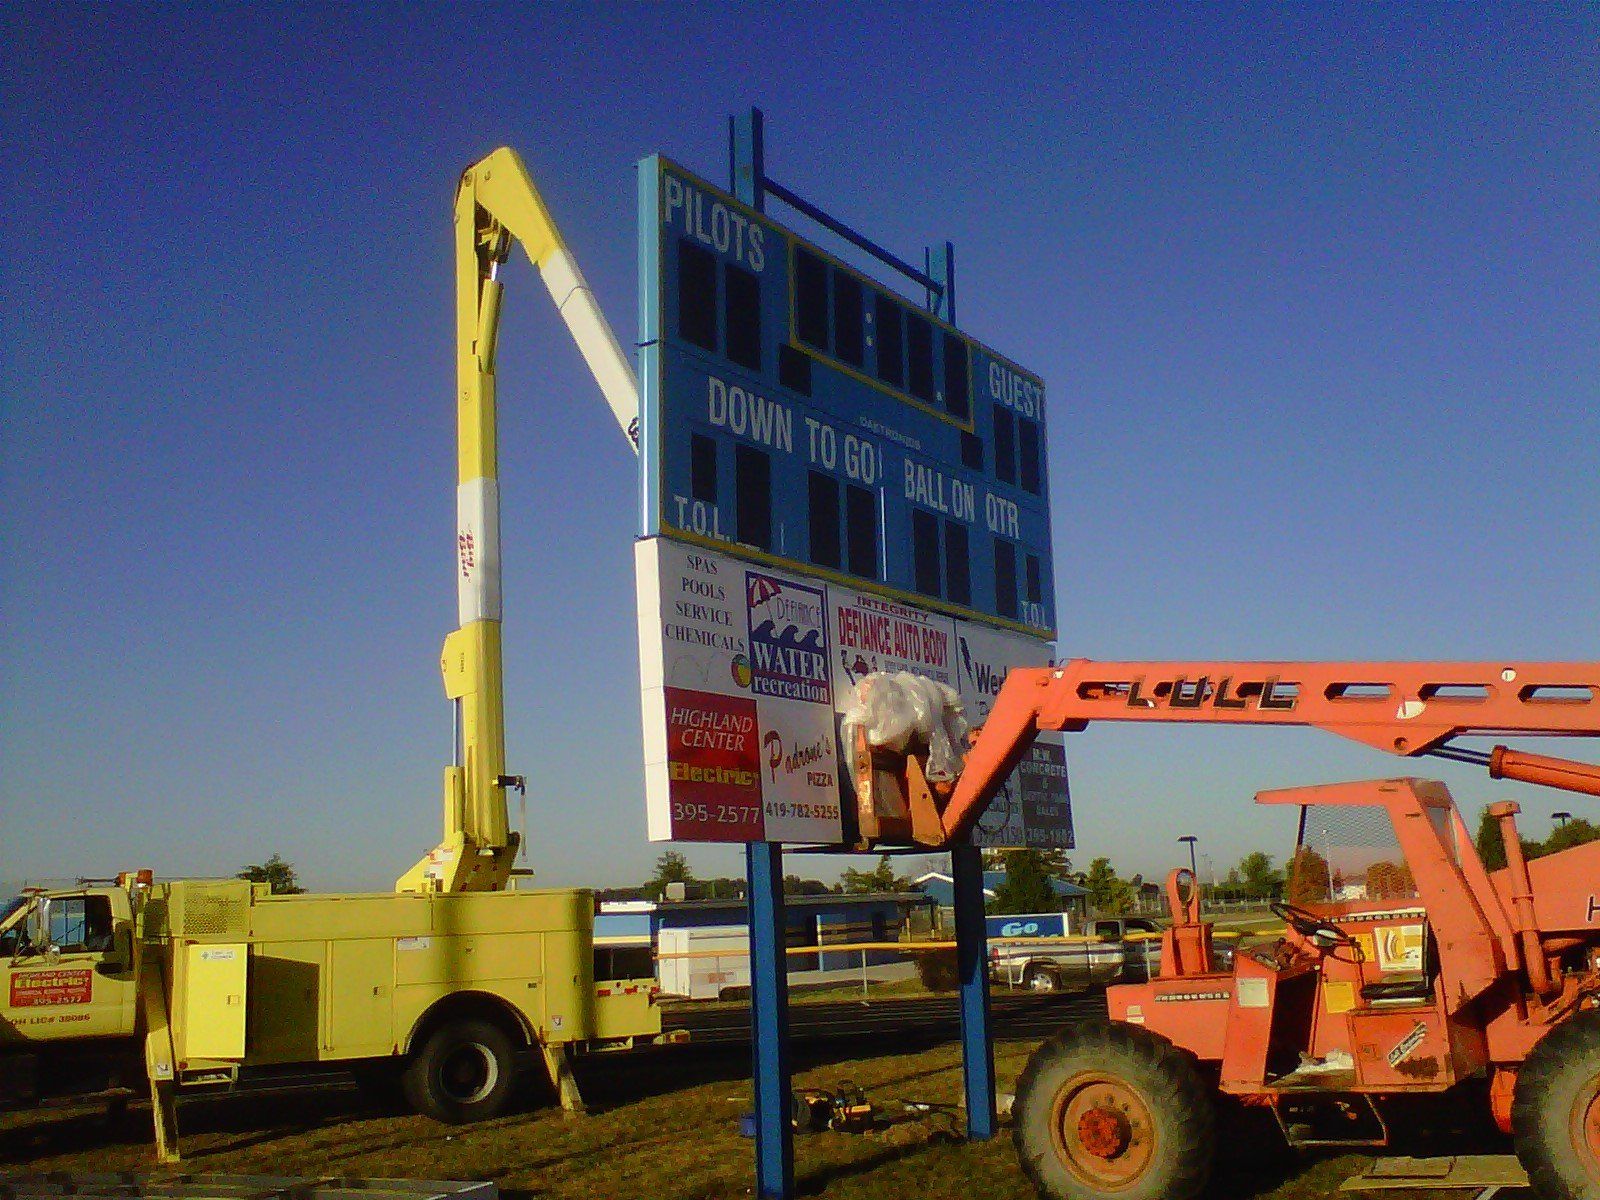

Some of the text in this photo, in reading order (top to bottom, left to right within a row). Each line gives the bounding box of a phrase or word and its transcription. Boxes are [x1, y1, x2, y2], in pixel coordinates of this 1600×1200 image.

[663, 174, 765, 273] PILOTS
[988, 361, 1045, 422] GUEST
[708, 375, 875, 486] DOWN TO GO
[904, 458, 1021, 540] BALL ON QTR
[686, 554, 719, 576] SPAS
[681, 576, 726, 602] POOLS
[675, 600, 733, 627] SERVICE
[857, 595, 929, 622] INTEGRITY
[664, 623, 745, 653] CHEMICALS
[838, 605, 949, 668] DEFIANCE AUTO BODY
[753, 639, 828, 682] WATER
[753, 675, 829, 704] recreation
[1127, 674, 1297, 712] LULL
[671, 707, 754, 734] HIGHLAND
[681, 729, 745, 752] CENTER
[806, 771, 834, 788] PIZZA
[674, 802, 761, 824] 395-2577
[765, 801, 839, 820] 419-782-5255
[1001, 921, 1039, 938] Go
